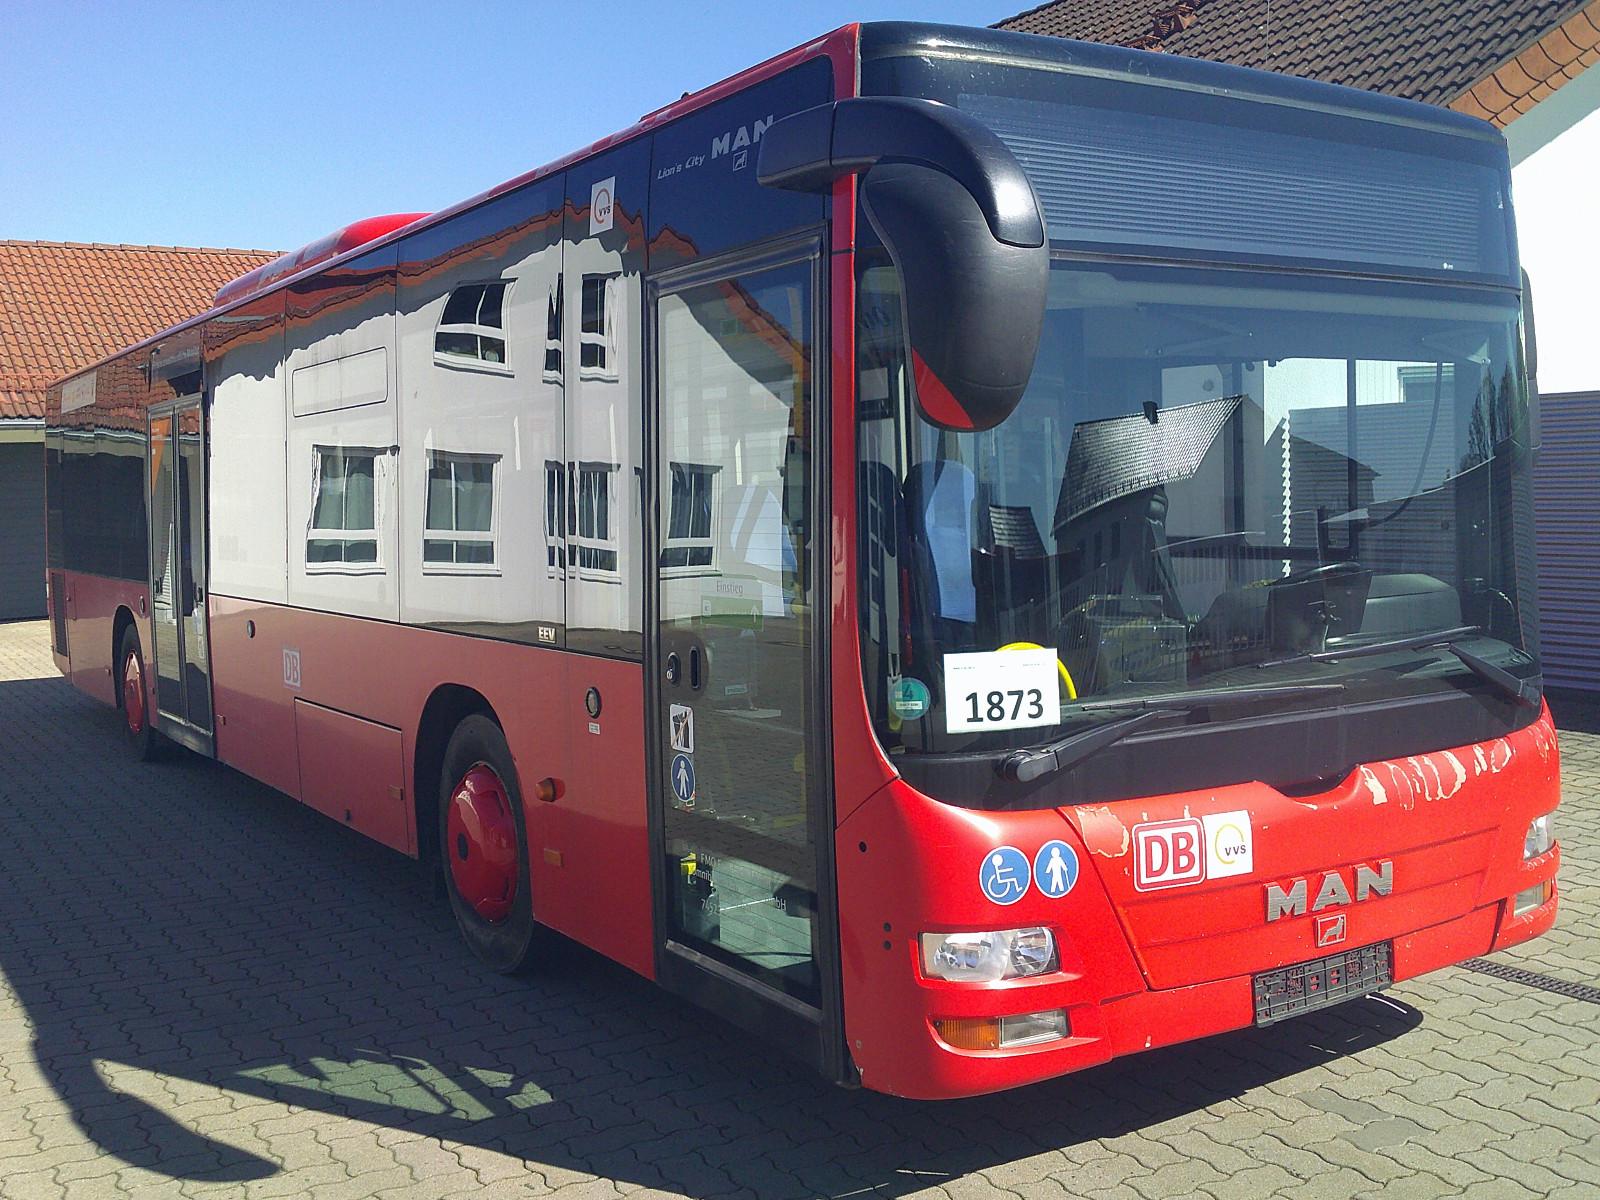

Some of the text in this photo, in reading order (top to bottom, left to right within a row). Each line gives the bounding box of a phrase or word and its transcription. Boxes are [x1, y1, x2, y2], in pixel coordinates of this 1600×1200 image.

[711, 114, 774, 159] MAN
[657, 152, 706, 180] Lion's City
[599, 205, 611, 216] VVS
[716, 581, 744, 598] Einstieg
[538, 626, 556, 641] EEV
[285, 652, 299, 684] DB
[902, 683, 914, 700] 4
[965, 688, 1044, 723] 1873
[1144, 831, 1196, 879] DB
[1224, 844, 1247, 857] VVS
[1265, 858, 1394, 922] MAN
